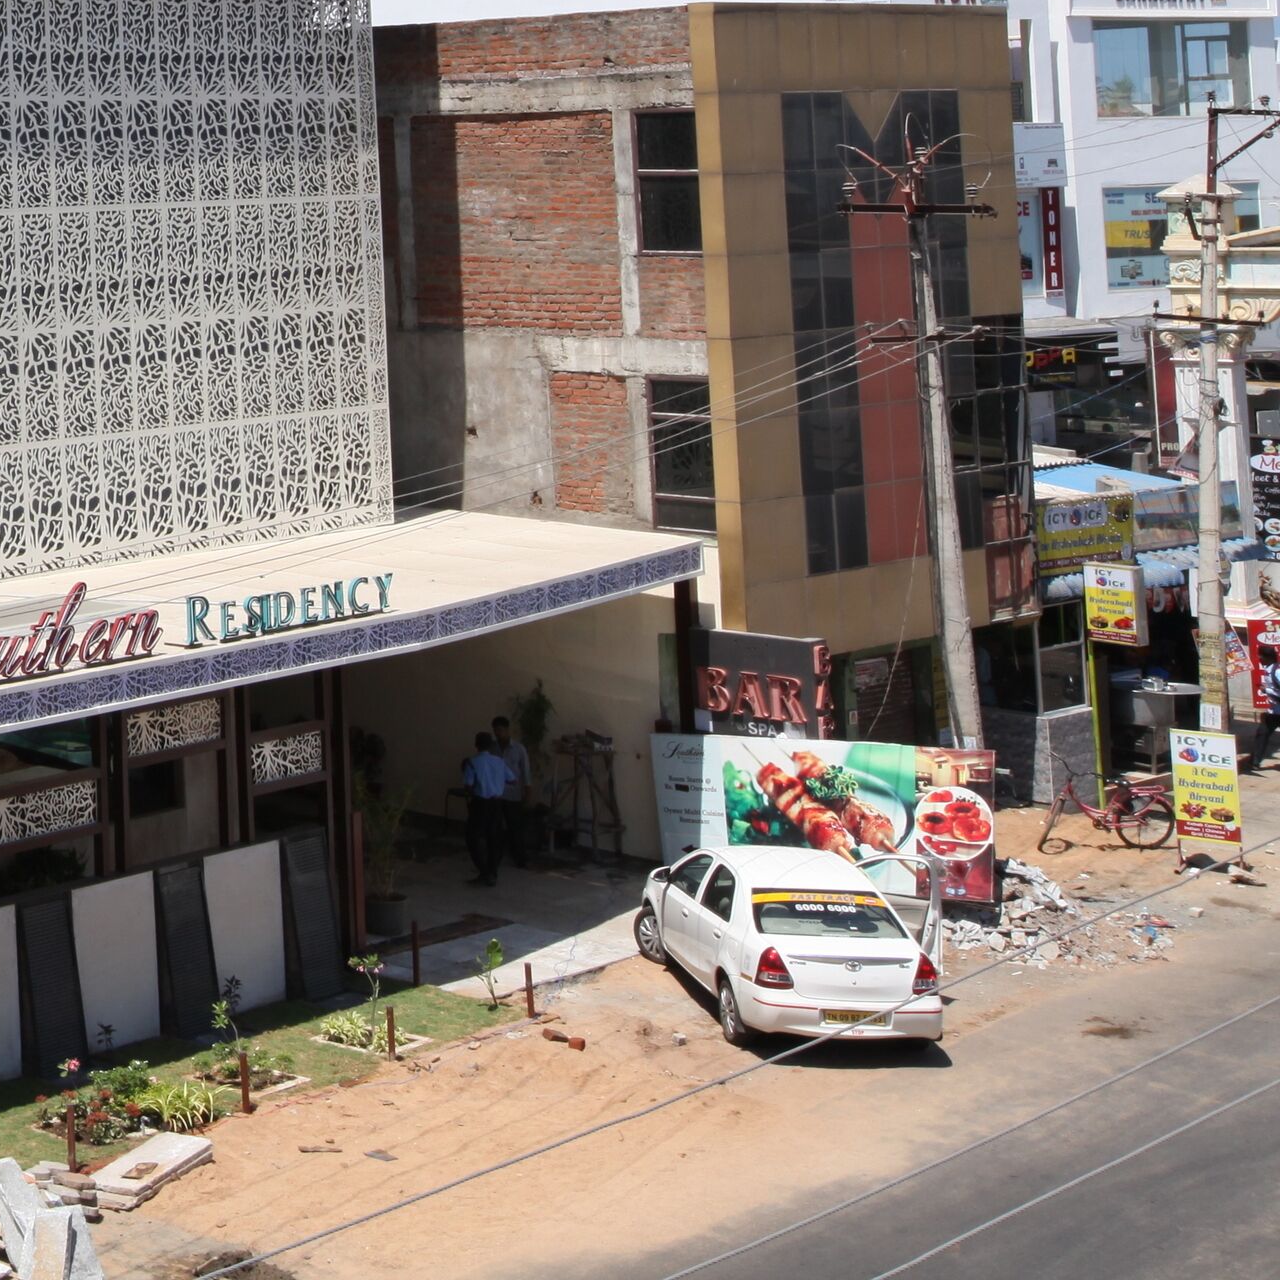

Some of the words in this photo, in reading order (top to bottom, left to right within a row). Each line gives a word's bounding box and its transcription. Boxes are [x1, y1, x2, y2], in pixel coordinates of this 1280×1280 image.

[1048, 513, 1067, 526] ICY
[1094, 569, 1112, 577] ICY
[1108, 580, 1126, 588] ICE
[184, 572, 394, 646] RESIDENCY
[697, 667, 807, 724] BAR
[1176, 735, 1207, 747] ICY
[1201, 754, 1231, 765] ICE
[791, 893, 817, 901] FAST
[827, 904, 856, 913] 6000
